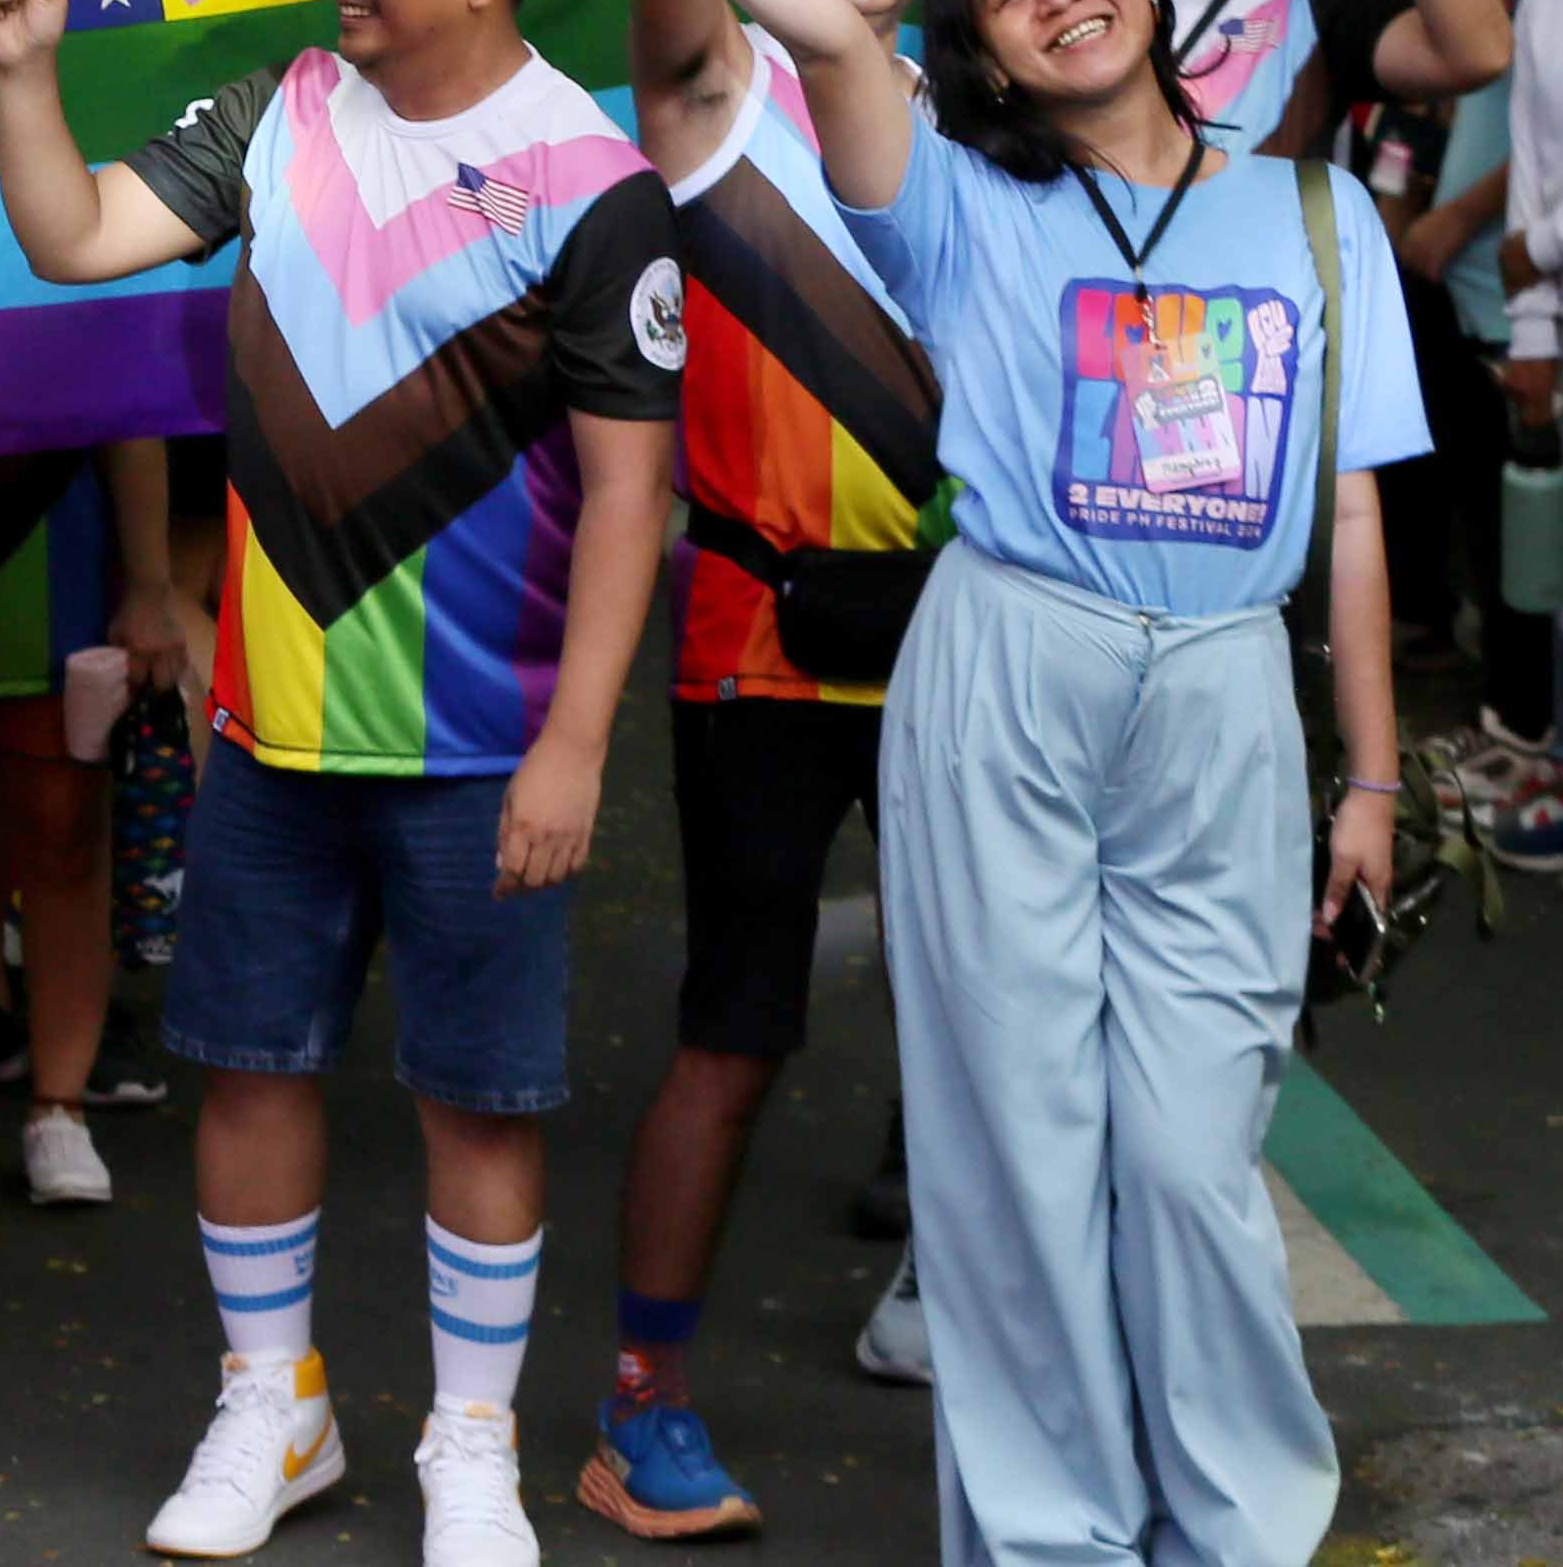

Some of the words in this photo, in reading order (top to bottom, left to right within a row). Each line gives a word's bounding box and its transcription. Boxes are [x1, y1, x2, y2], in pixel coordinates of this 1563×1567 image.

[1068, 483, 1089, 505] 2
[1094, 485, 1268, 524] EVERYONE!
[1069, 507, 1120, 525] PRIDE
[1127, 511, 1151, 527] PH
[1156, 513, 1232, 538] FESTIVAL
